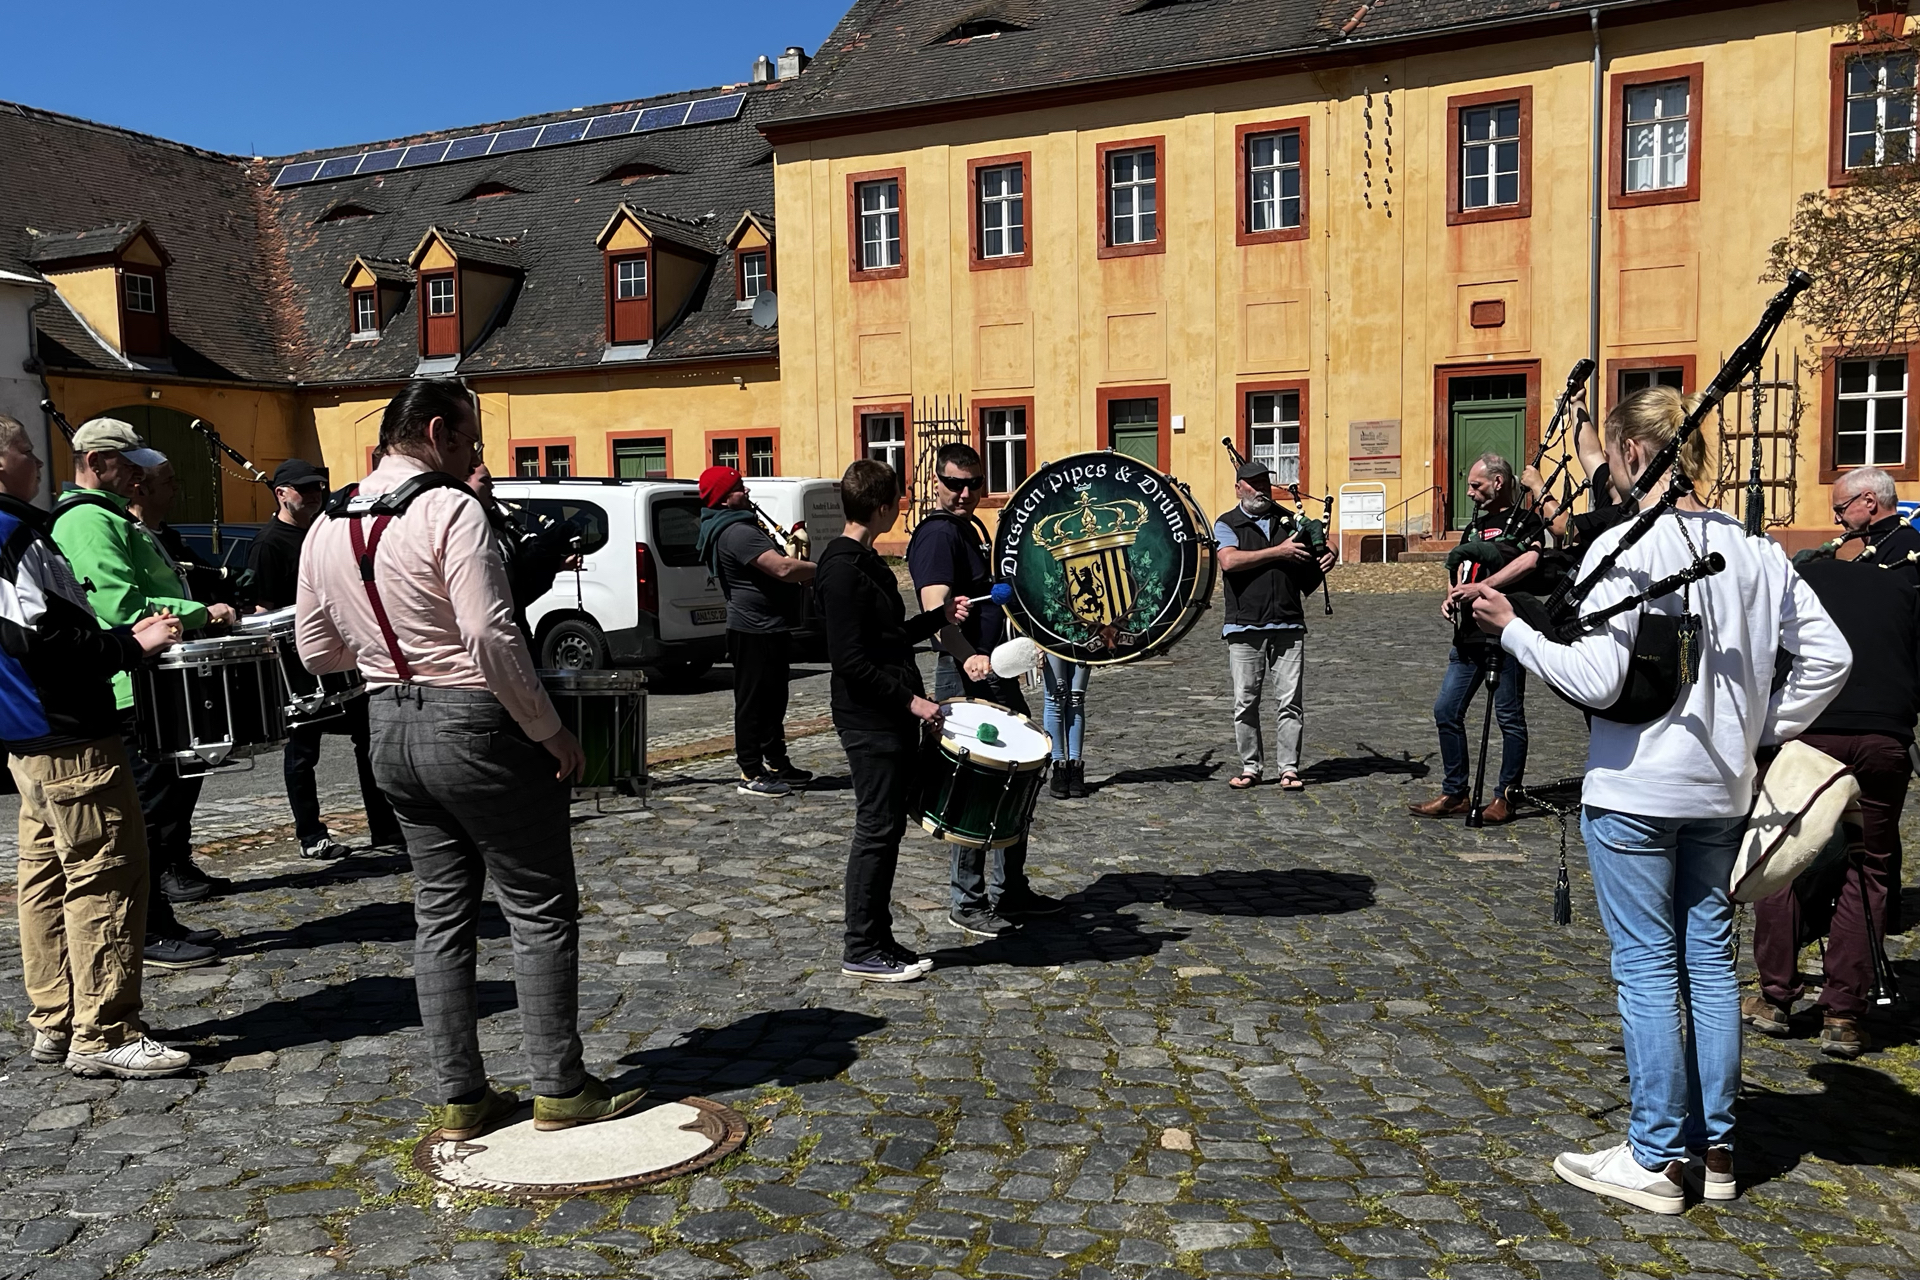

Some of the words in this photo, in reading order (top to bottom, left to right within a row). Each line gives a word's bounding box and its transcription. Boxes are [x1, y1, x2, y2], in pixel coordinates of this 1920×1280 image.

[1001, 488, 1045, 577] Dresden
[1115, 465, 1132, 483] &
[1137, 474, 1187, 544] Drums
